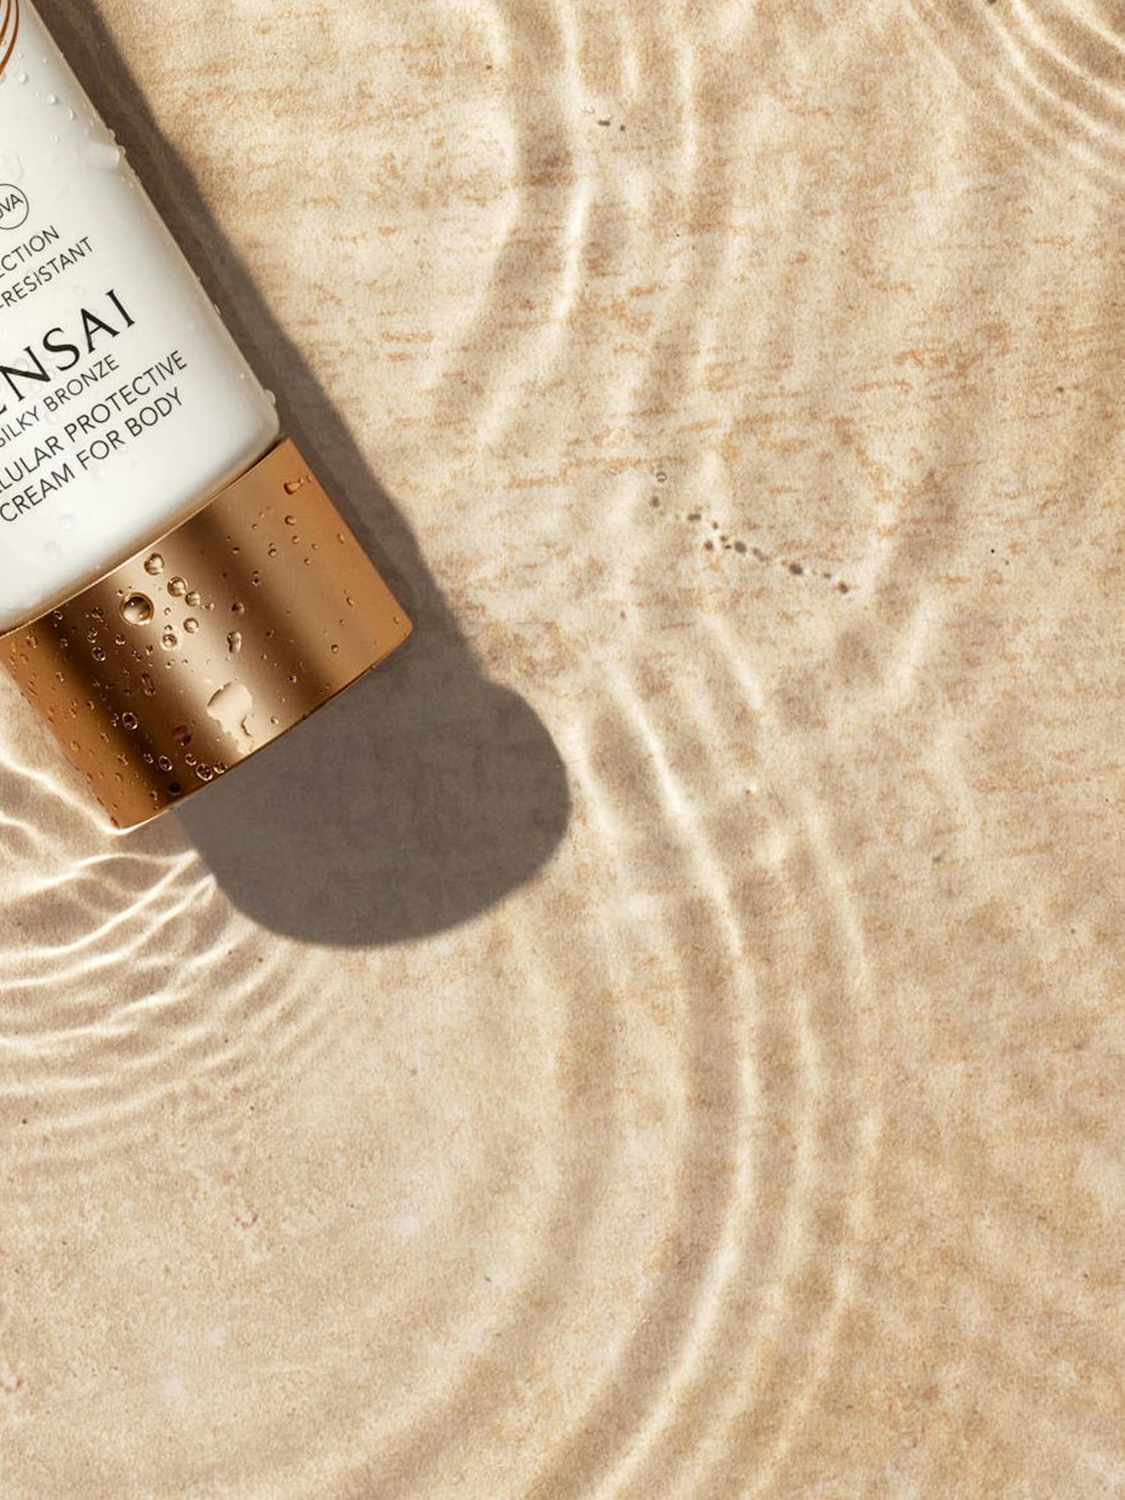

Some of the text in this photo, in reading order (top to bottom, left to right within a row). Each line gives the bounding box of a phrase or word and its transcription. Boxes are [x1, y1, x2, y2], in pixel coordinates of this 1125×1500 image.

[43, 354, 120, 413] BRONZE
[64, 350, 187, 443] PROTECTIVE
[0, 387, 183, 522] CREAM FOR BODY
